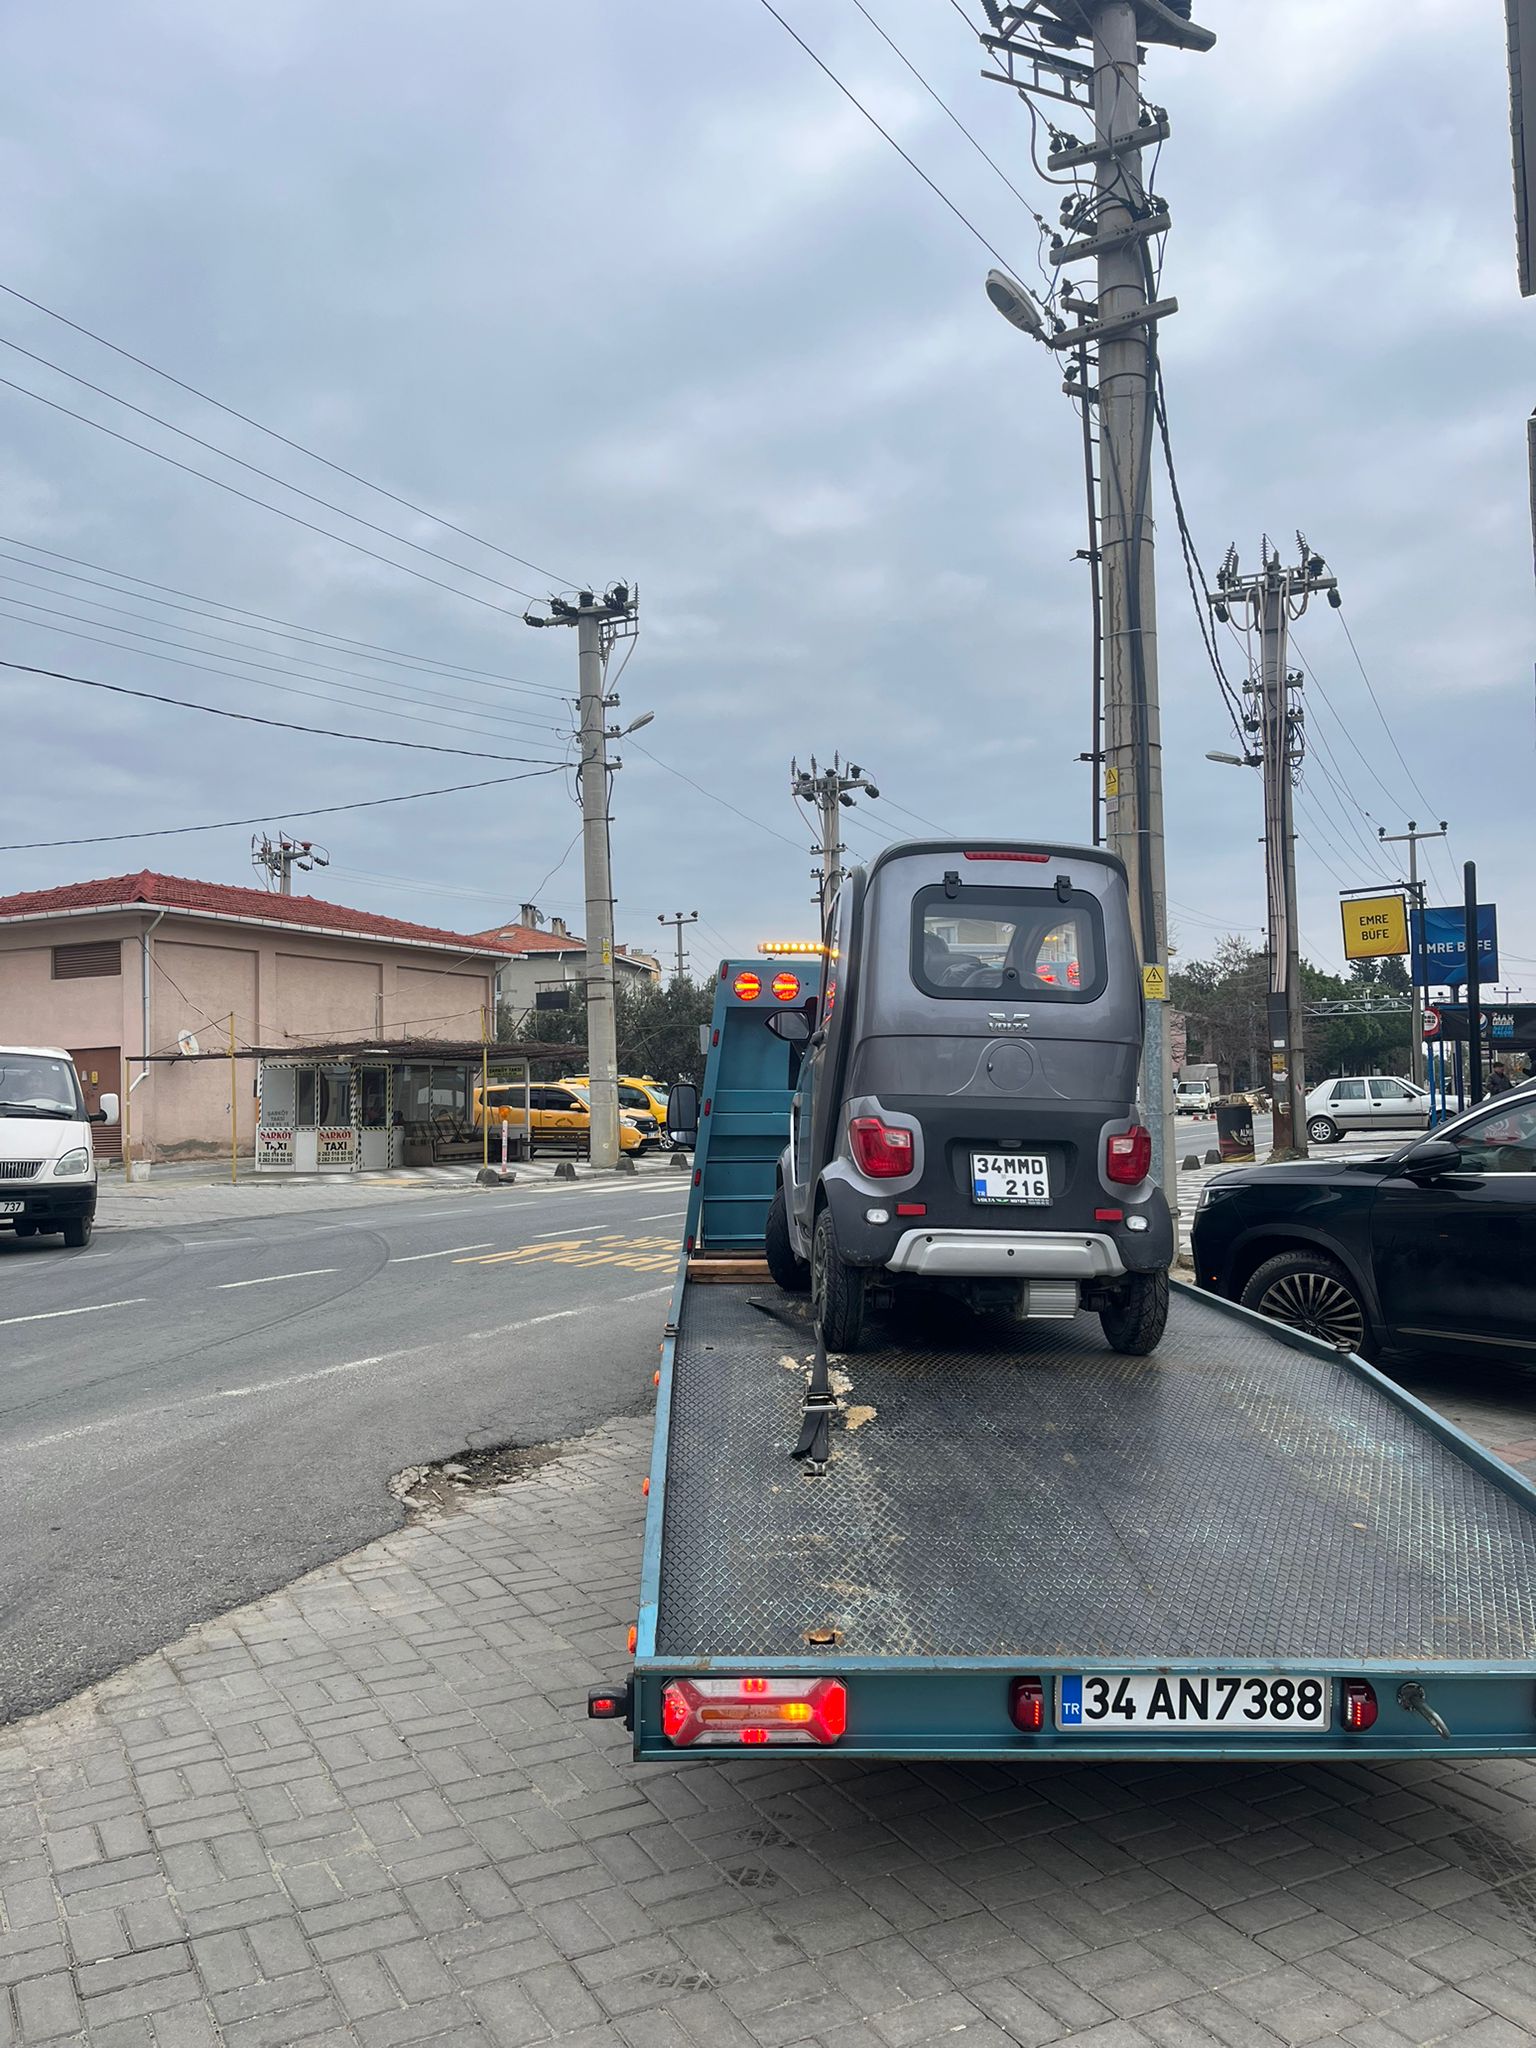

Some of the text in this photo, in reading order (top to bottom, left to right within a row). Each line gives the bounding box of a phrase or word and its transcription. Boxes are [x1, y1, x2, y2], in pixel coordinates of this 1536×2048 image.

[1359, 914, 1389, 926] EMRE
[1361, 927, 1390, 941] BÜFE
[1457, 939, 1492, 953] BFE
[988, 1021, 1030, 1033] VOLTA
[324, 1142, 347, 1151] TAXI
[1005, 1179, 1045, 1197] 216
[4, 1202, 22, 1212] 737
[1084, 1676, 1137, 1720] 34
[1063, 1702, 1081, 1716] TR
